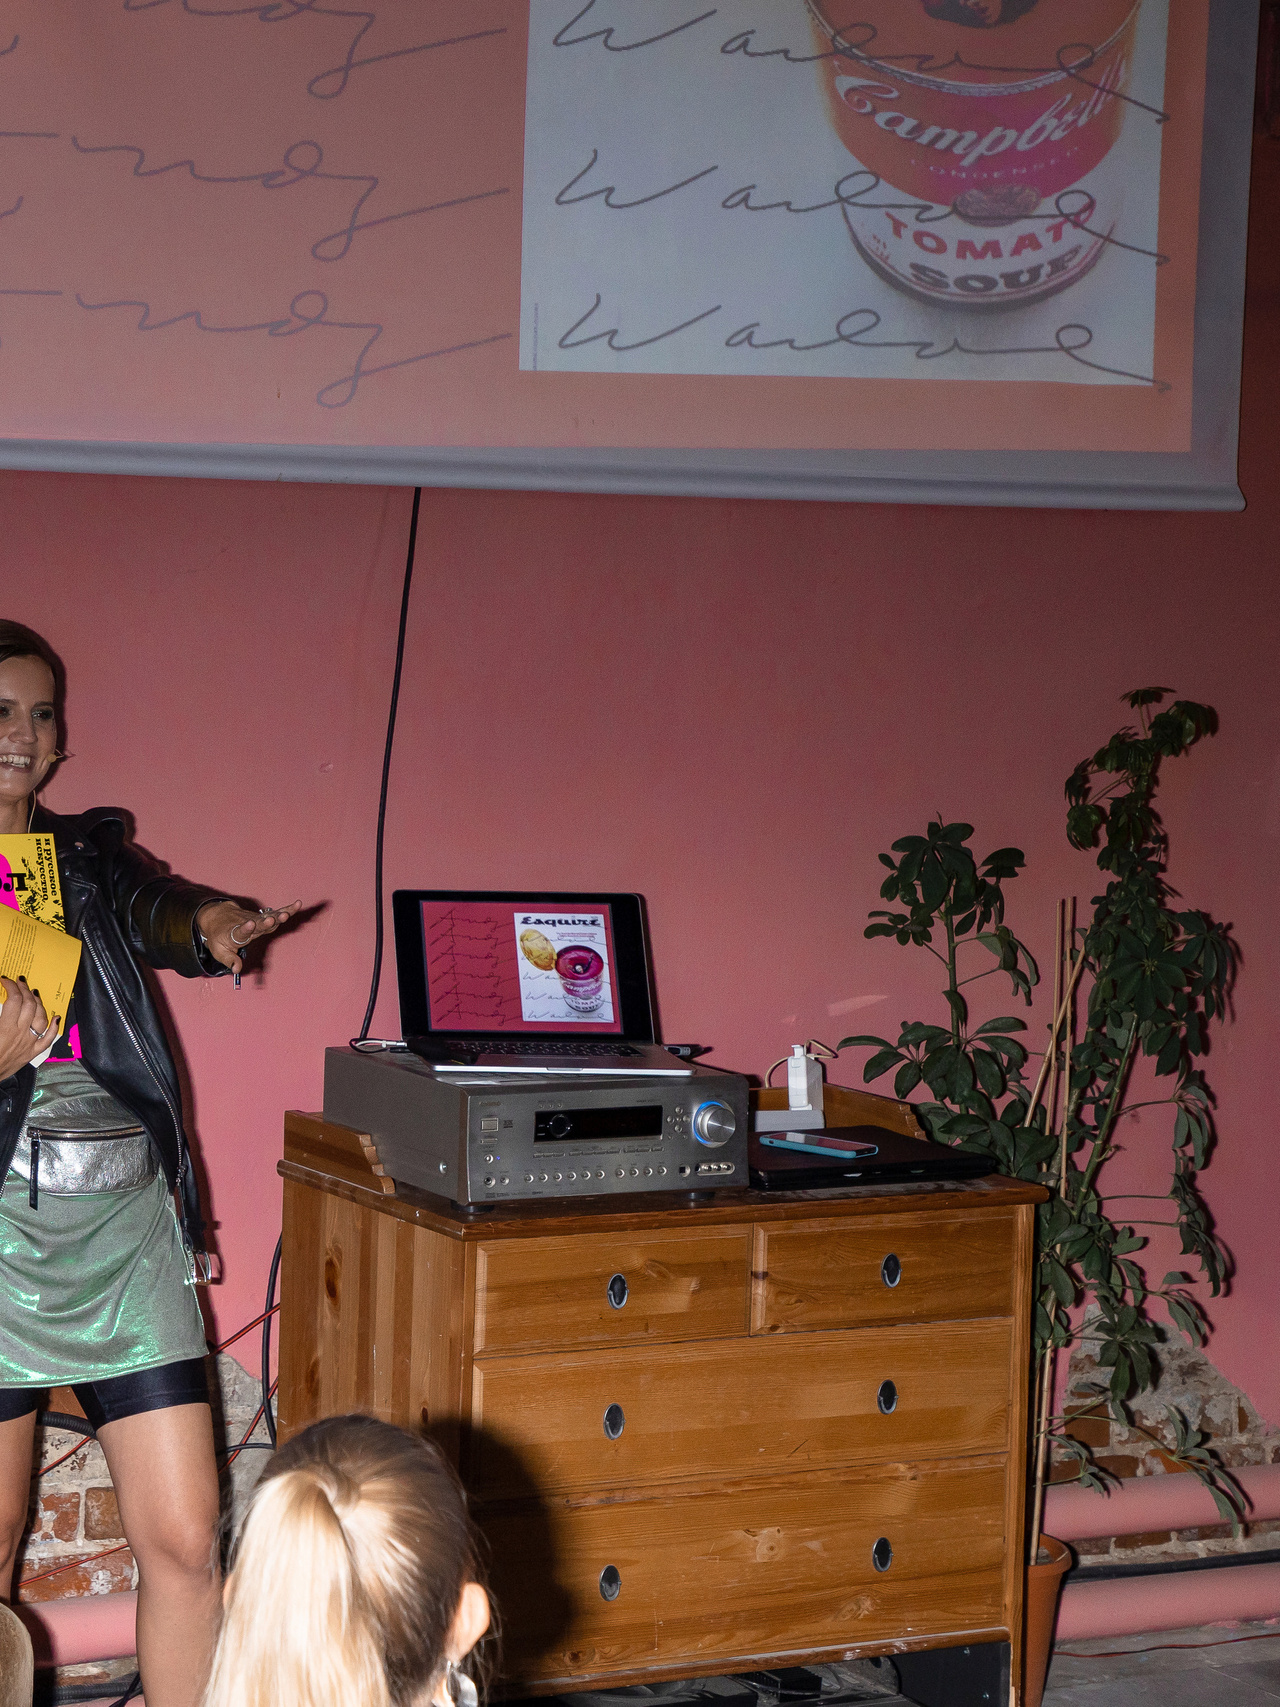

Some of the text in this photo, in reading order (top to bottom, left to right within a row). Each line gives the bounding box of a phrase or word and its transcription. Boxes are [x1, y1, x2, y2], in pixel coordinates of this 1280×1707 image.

[909, 245, 1082, 293] SOUP
[35, 838, 49, 901] искусство
[43, 838, 57, 897] и русское
[520, 915, 601, 928] Esquire
